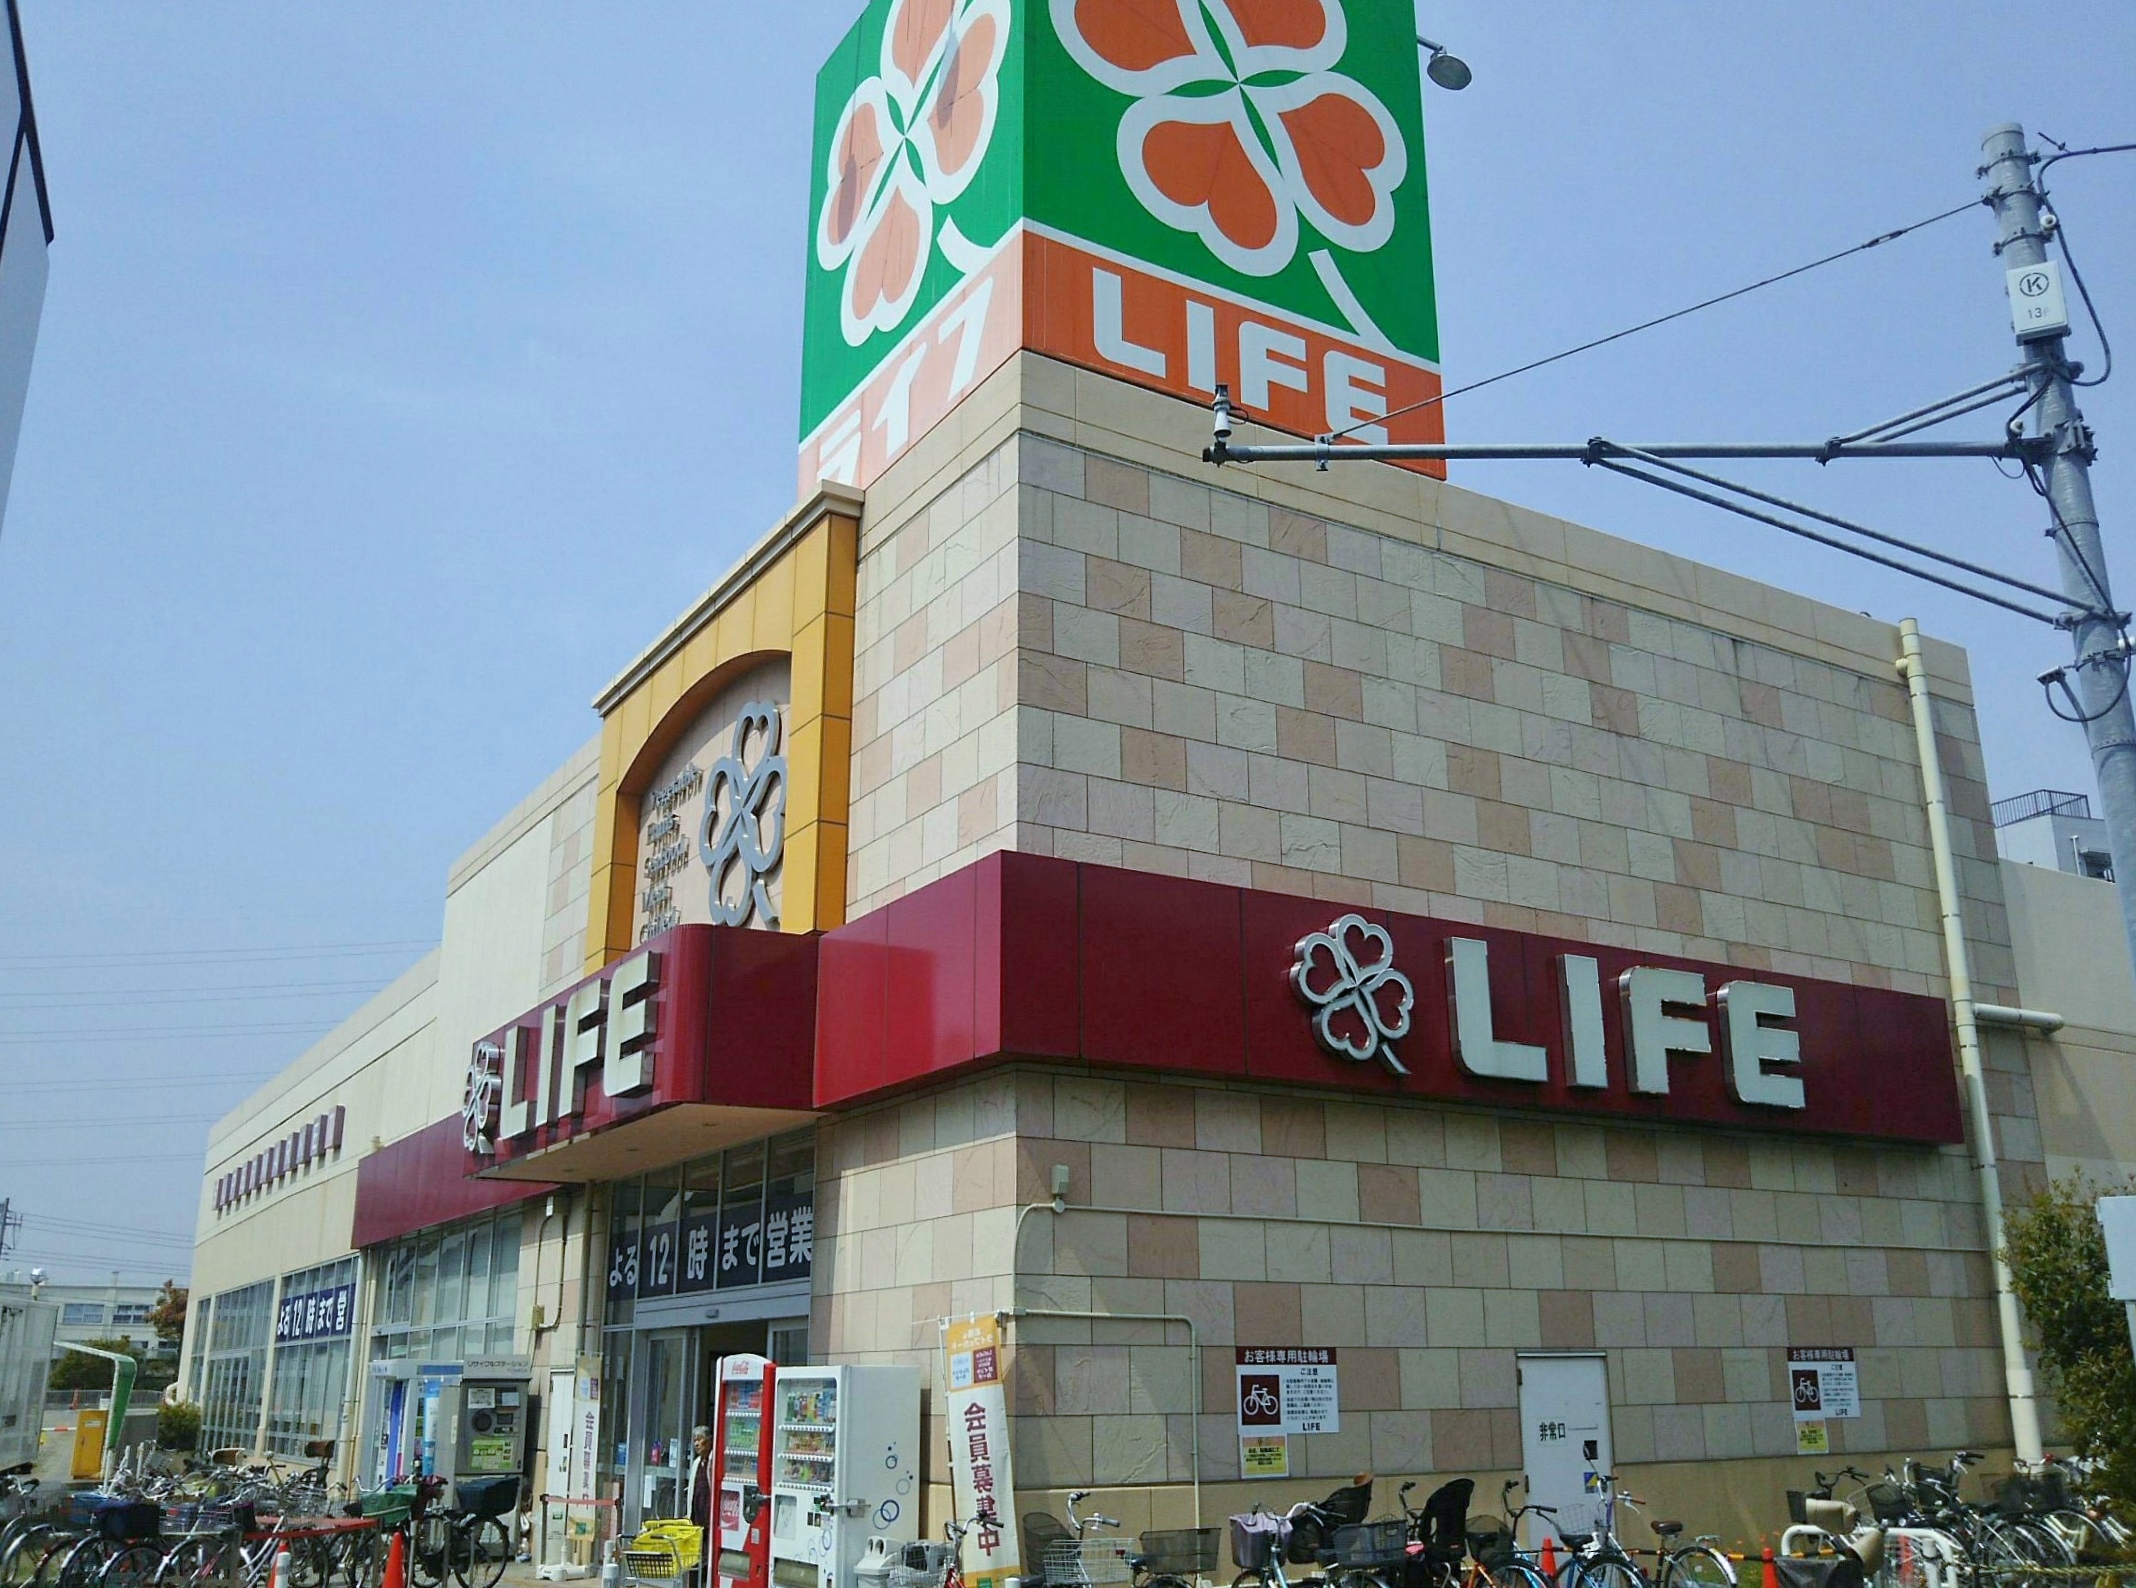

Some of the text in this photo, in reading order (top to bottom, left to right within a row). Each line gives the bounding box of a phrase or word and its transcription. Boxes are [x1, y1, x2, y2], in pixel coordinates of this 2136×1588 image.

[1091, 265, 1388, 452] LIFE
[501, 950, 658, 1141] LIFE
[1443, 936, 1806, 1109] LIFE
[1244, 1349, 1329, 1364] お客様専用駐輪場
[1302, 1422, 1321, 1431] LIFE
[1539, 1421, 1566, 1441] 非常口
